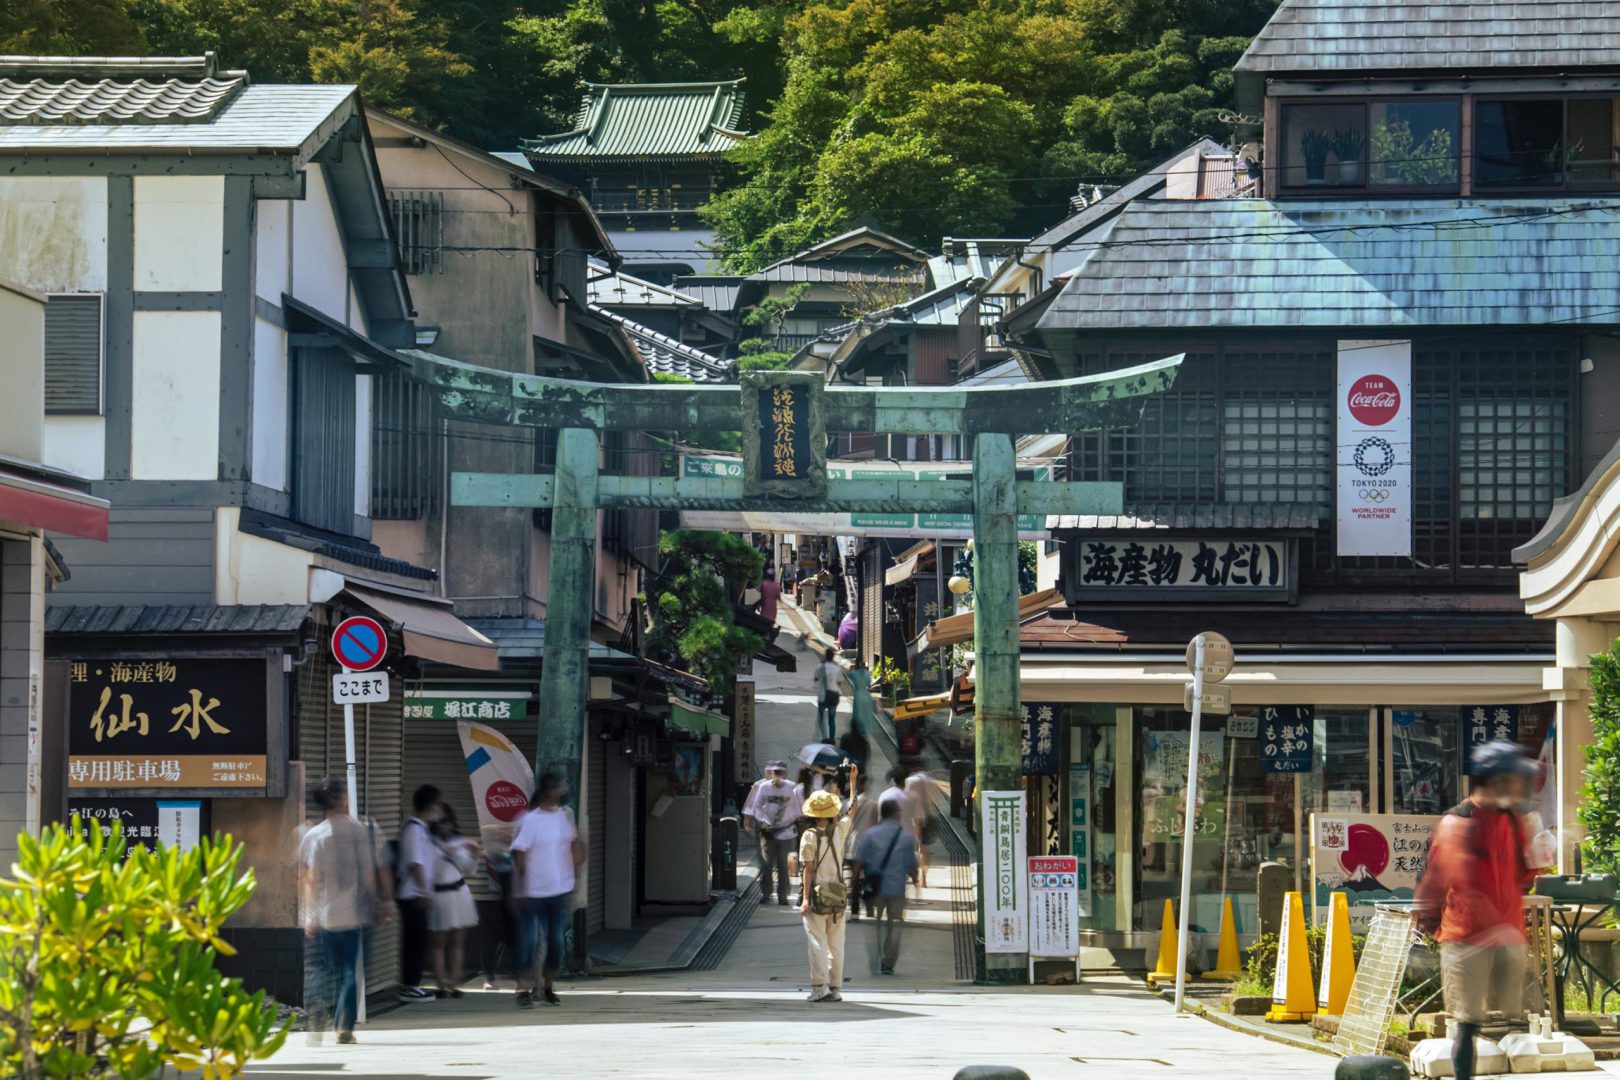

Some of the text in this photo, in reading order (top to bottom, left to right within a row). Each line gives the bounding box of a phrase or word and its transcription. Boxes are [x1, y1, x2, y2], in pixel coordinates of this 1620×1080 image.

[1350, 391, 1398, 408] Coca-Cola
[687, 460, 741, 476] ご来島の
[1082, 542, 1280, 586] 海産物 丸だい
[71, 662, 177, 683] 理・海産物
[339, 679, 383, 696] ここまで
[90, 686, 231, 743] 仙水
[444, 701, 511, 718] 堀江商店
[1264, 707, 1278, 757] ひもの
[1295, 707, 1309, 751] いかの
[1470, 706, 1488, 743] 専門
[1493, 707, 1511, 742] 海産
[1281, 725, 1296, 757] 塩辛
[68, 760, 181, 782] 専用駐車場
[1034, 861, 1072, 870] おねがい
